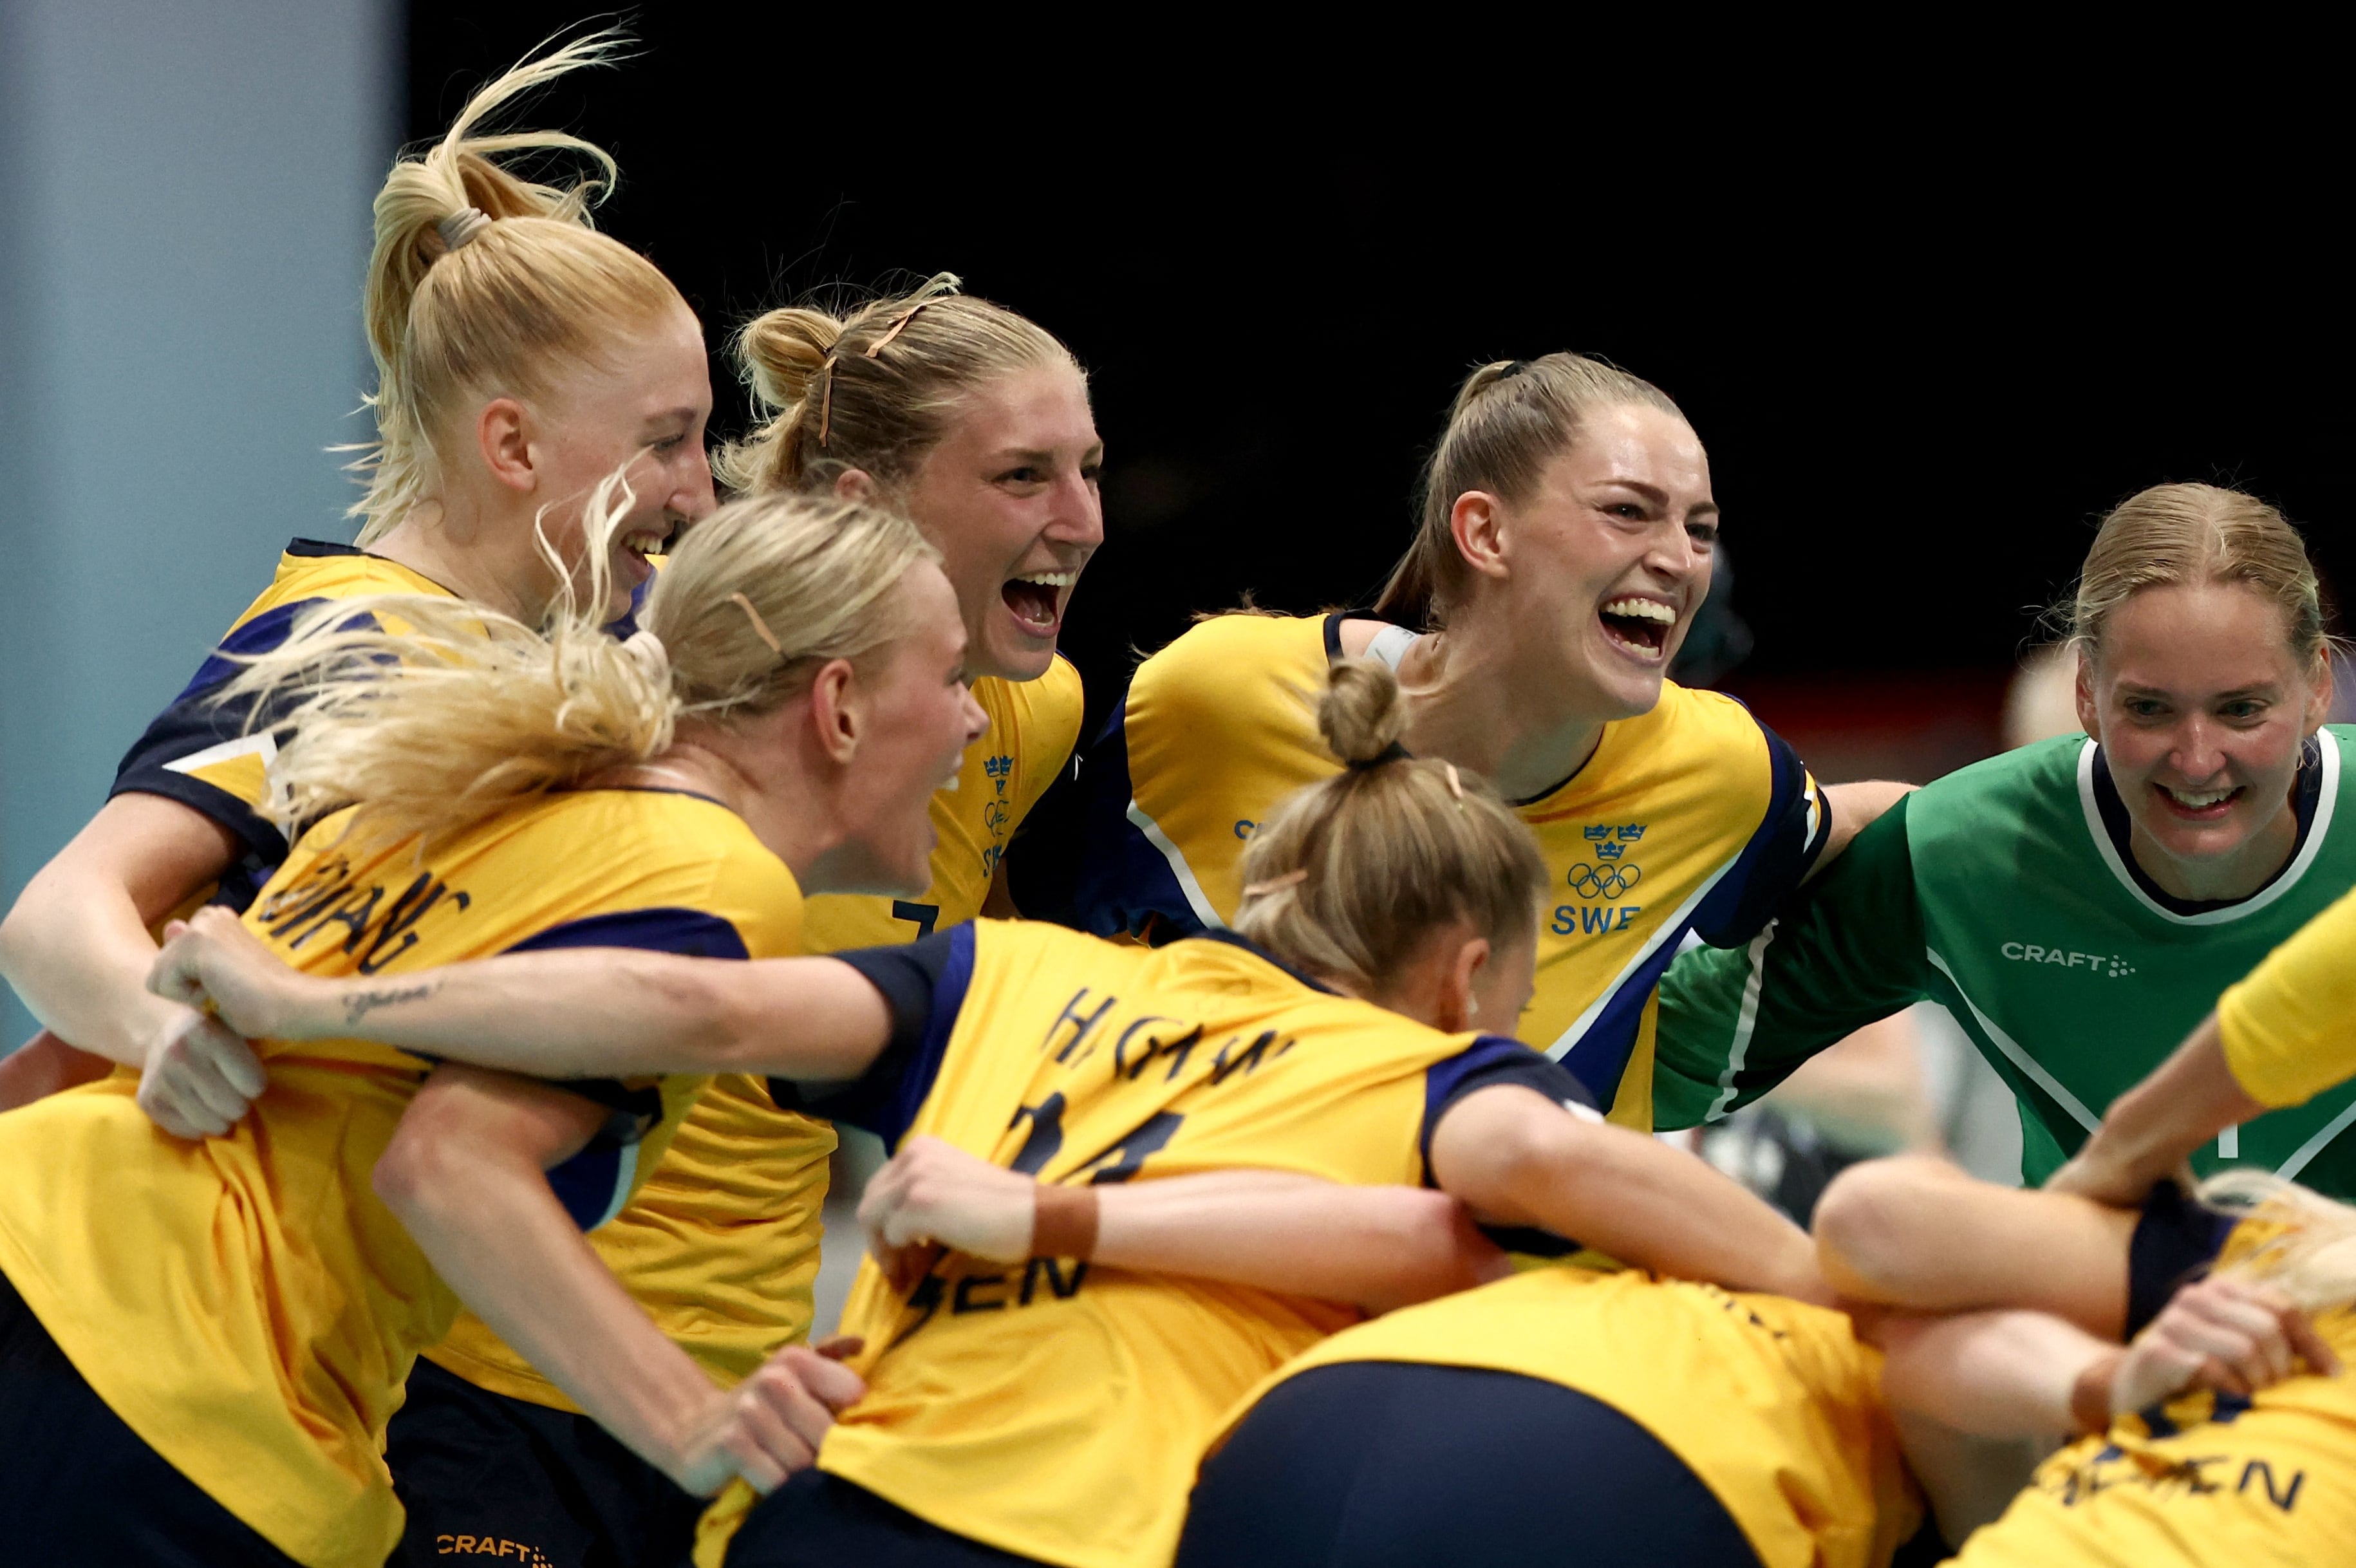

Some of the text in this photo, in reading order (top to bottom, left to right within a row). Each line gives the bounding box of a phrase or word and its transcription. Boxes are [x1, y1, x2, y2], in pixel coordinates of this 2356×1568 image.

[1551, 904, 1641, 935] SWE
[2000, 941, 2107, 971] CRAFT
[436, 1534, 530, 1563] CRAFT
